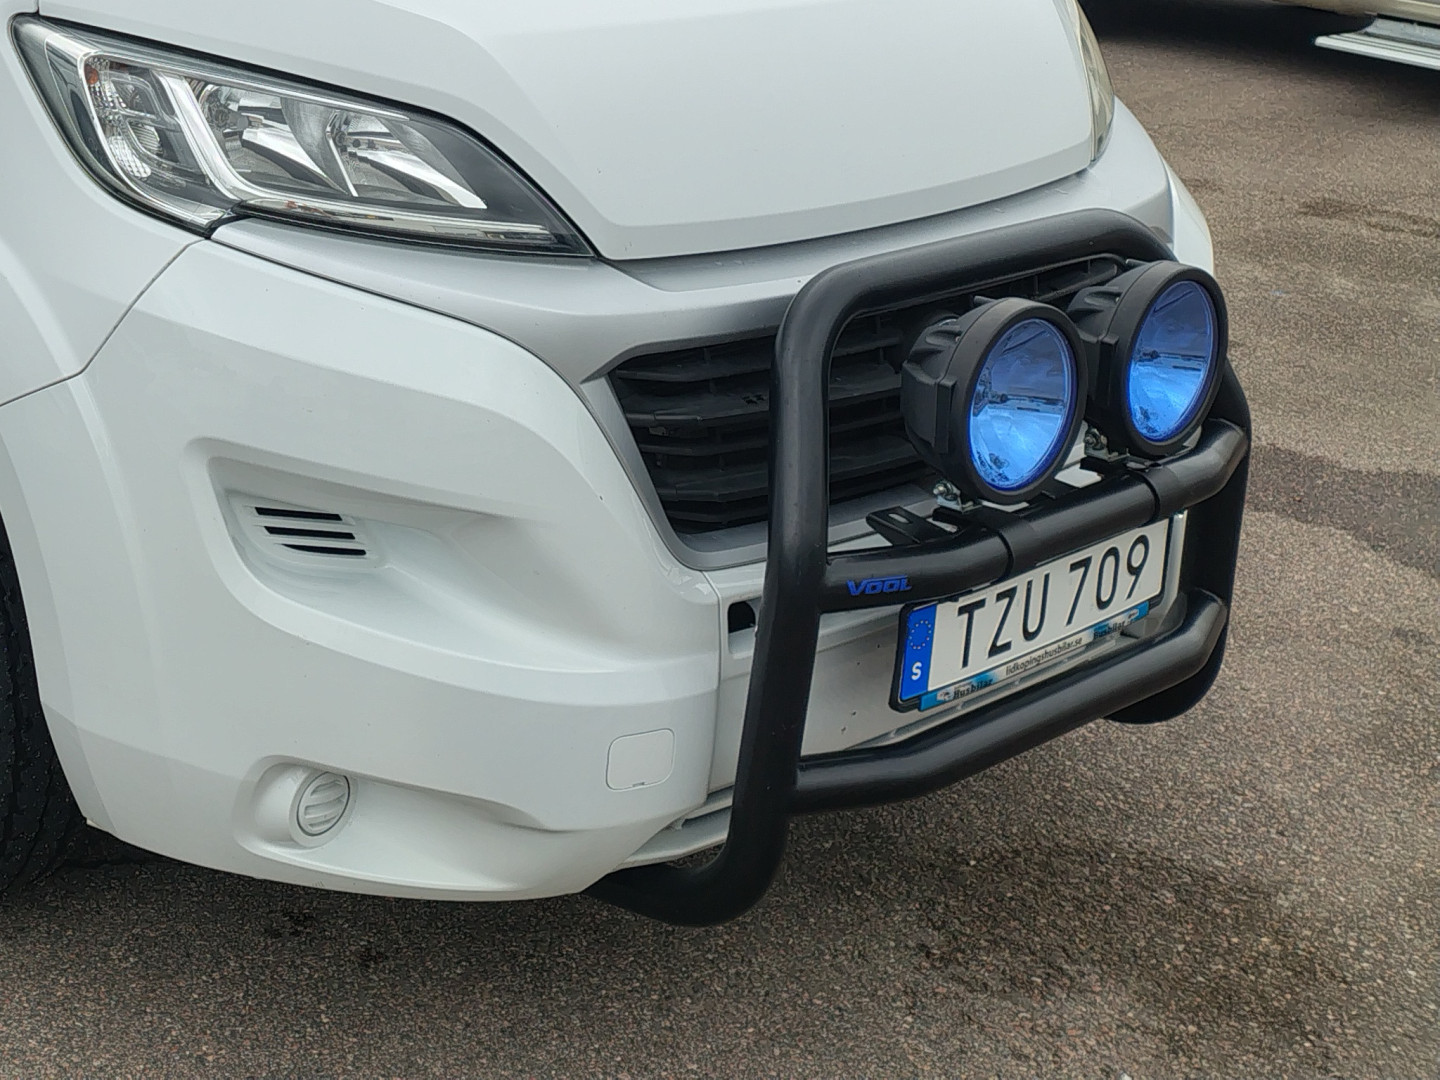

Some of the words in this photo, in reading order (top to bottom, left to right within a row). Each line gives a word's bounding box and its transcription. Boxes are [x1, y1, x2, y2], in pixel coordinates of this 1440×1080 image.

[958, 572, 1050, 669] TZU
[1065, 533, 1150, 627] 709
[910, 661, 923, 681] S
